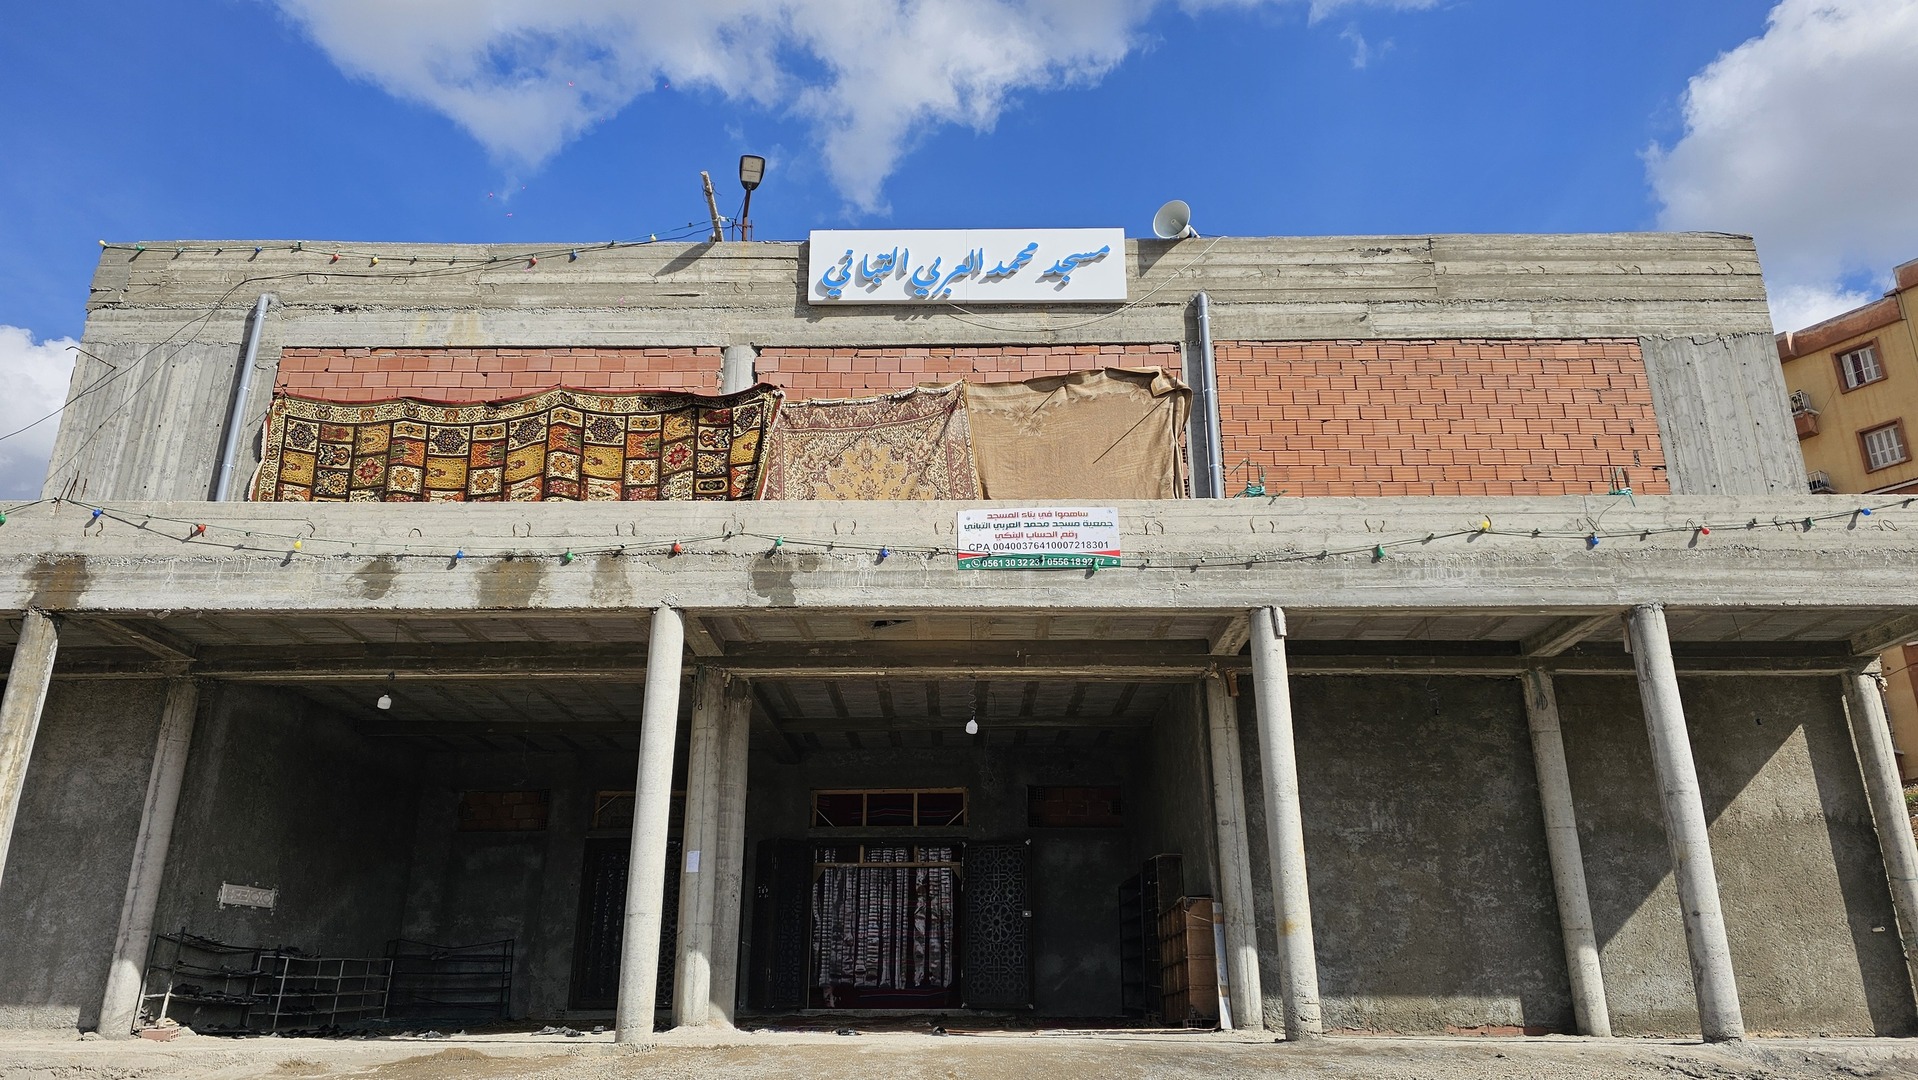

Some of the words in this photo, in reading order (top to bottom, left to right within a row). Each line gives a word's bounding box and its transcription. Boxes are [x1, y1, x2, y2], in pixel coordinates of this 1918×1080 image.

[986, 241, 1039, 276] محمد
[1042, 244, 1111, 284] مسجد
[821, 246, 910, 298] التباني
[910, 247, 984, 298] العربي
[987, 511, 1019, 521] المسجد
[1021, 511, 1036, 519] بناء
[1038, 511, 1053, 519] في
[1055, 511, 1089, 519] ساهموا
[964, 521, 991, 531] التباني
[993, 521, 1021, 531] العربي
[1052, 521, 1081, 529] مسجد
[1083, 520, 1114, 529] جمعية
[995, 531, 1024, 541] البنكي
[1026, 531, 1058, 540] الحساب
[1060, 530, 1078, 540] رقم
[968, 543, 991, 552] CPA
[993, 541, 1109, 551] 00400376410007218301
[982, 559, 1003, 567] 0561
[1005, 559, 1016, 567] 30
[1017, 559, 1028, 567] 32
[1047, 558, 1069, 566] 0556
